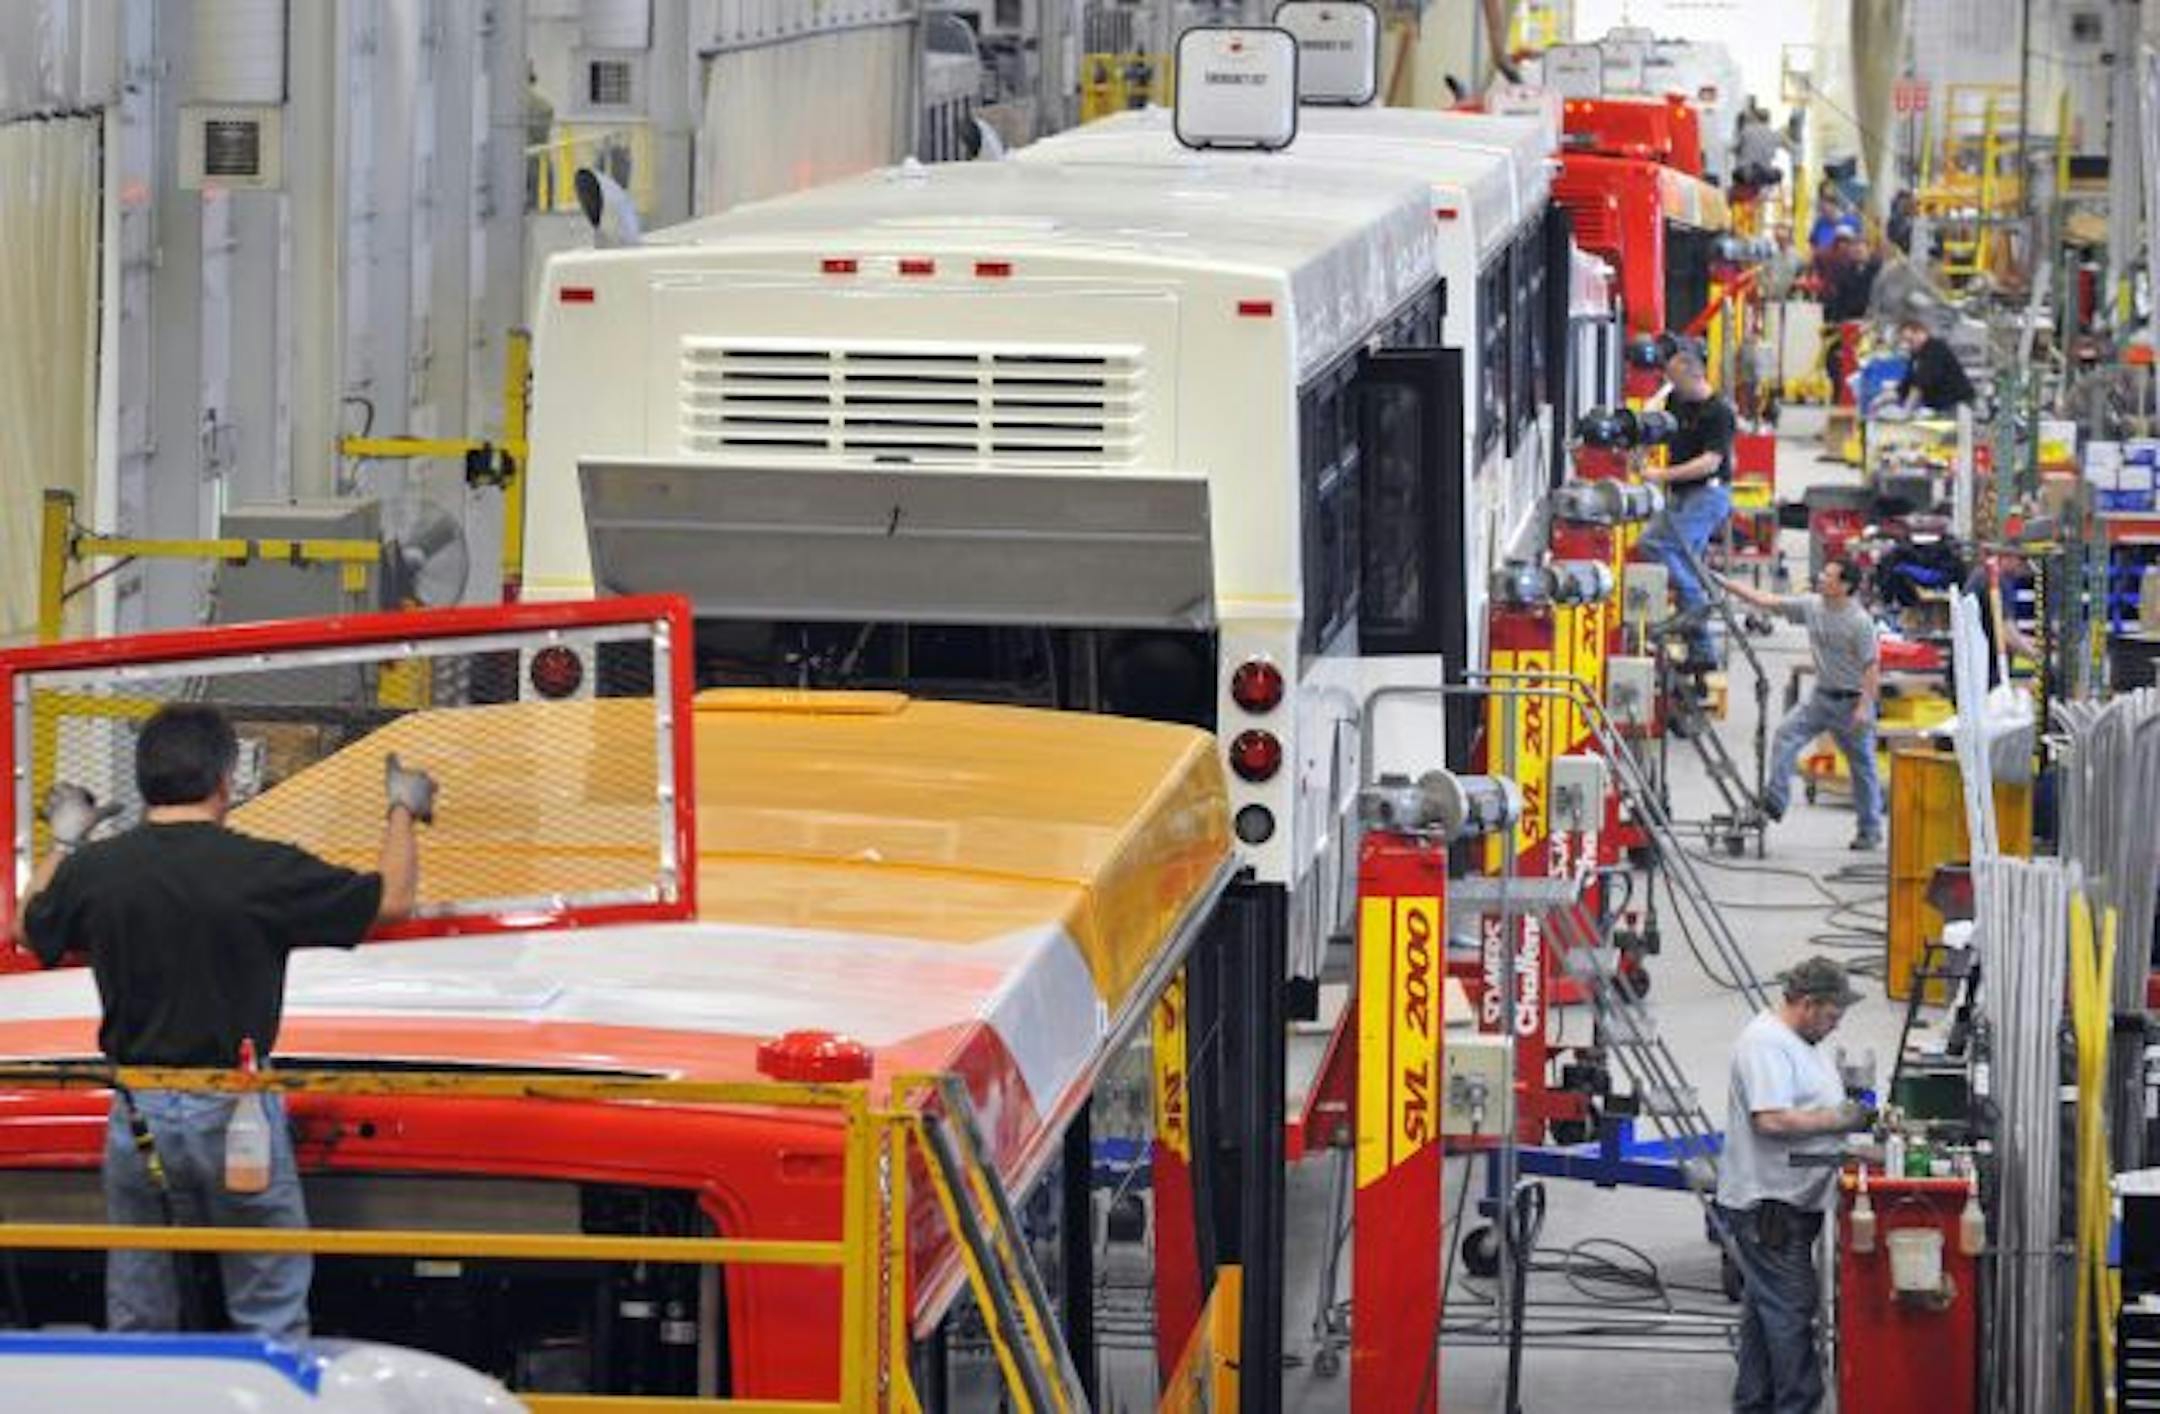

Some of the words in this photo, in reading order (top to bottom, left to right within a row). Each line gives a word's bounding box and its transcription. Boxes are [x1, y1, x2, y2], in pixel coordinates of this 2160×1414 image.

[1522, 776, 1541, 845] SVL
[1406, 907, 1430, 1040] 2000
[1403, 1062, 1428, 1147] SVL
